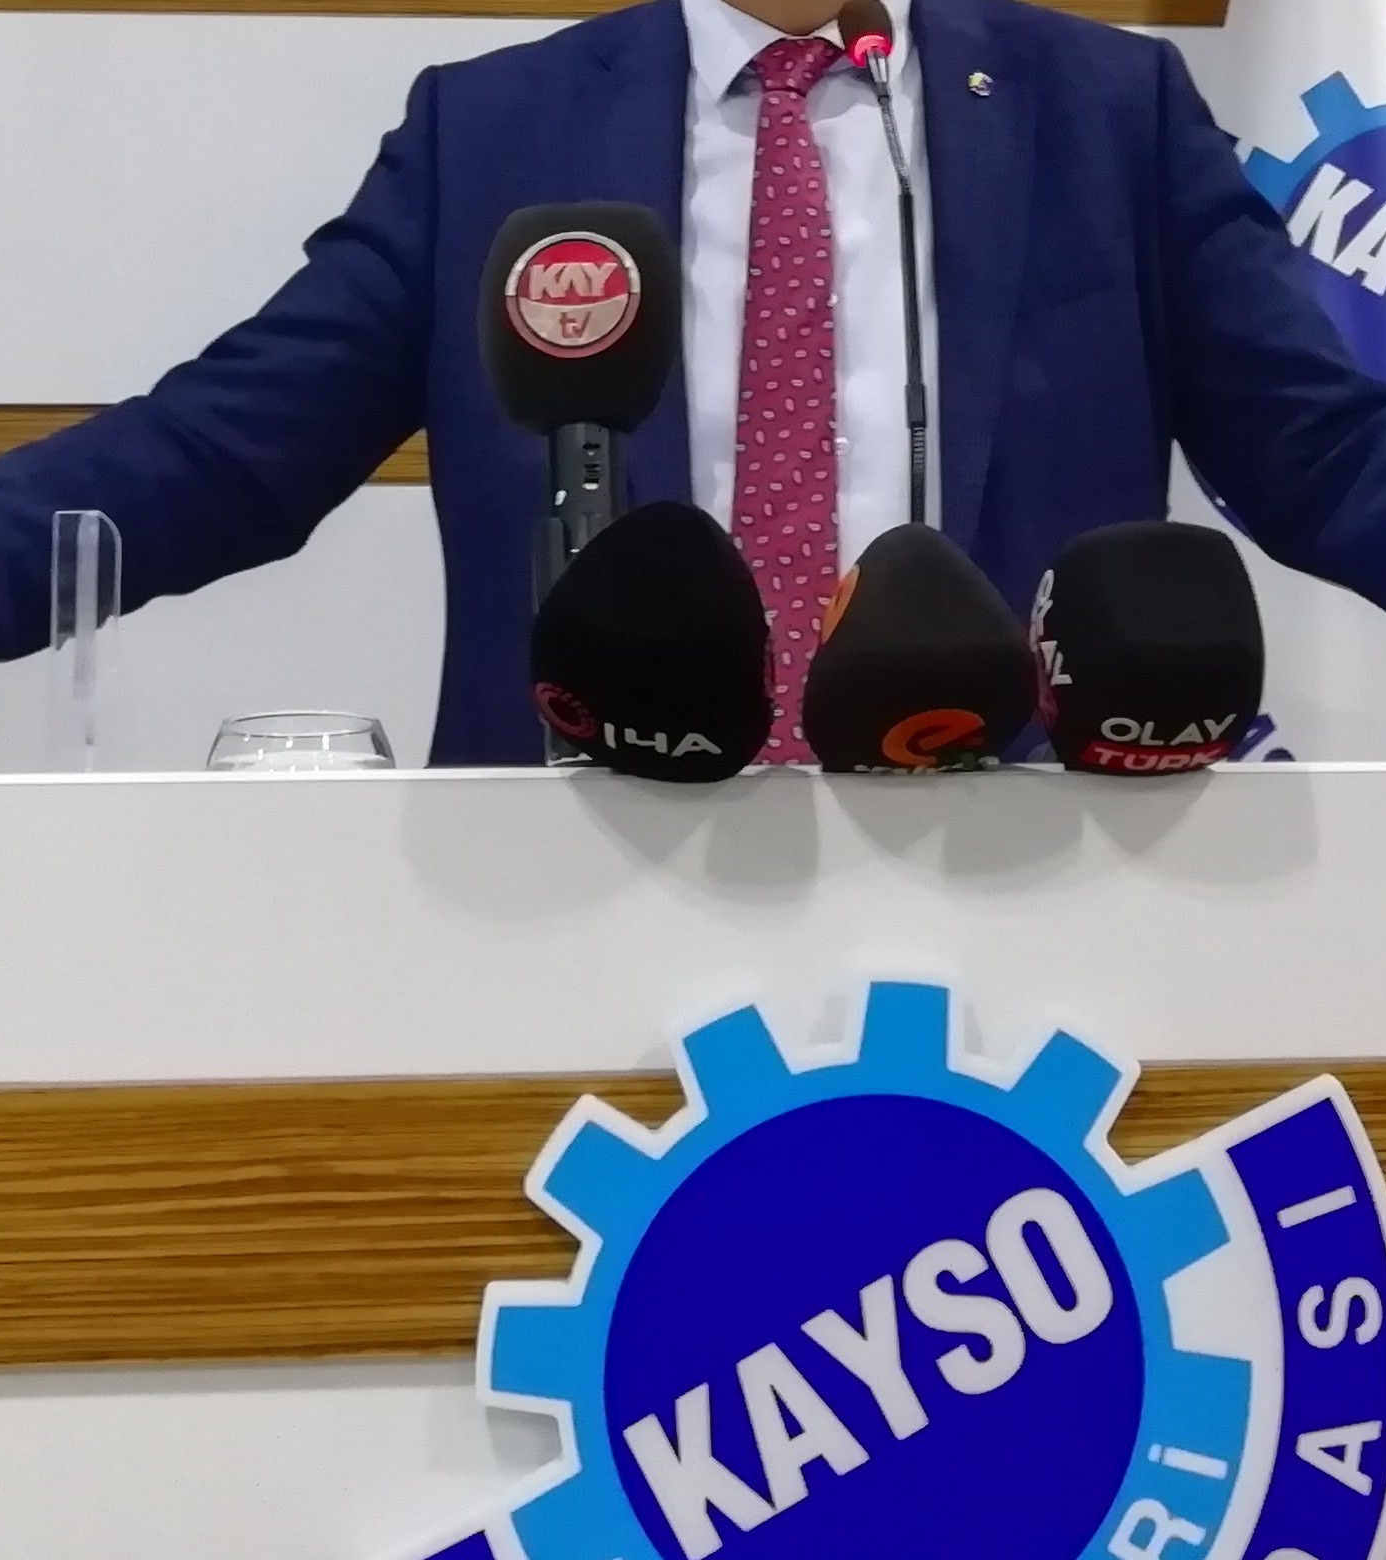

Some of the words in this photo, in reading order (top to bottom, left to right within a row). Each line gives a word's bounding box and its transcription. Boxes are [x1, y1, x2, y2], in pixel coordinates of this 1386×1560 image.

[528, 262, 618, 300] KAY
[1100, 713, 1238, 746] OLAY
[623, 1187, 1113, 1560] KAYSO
